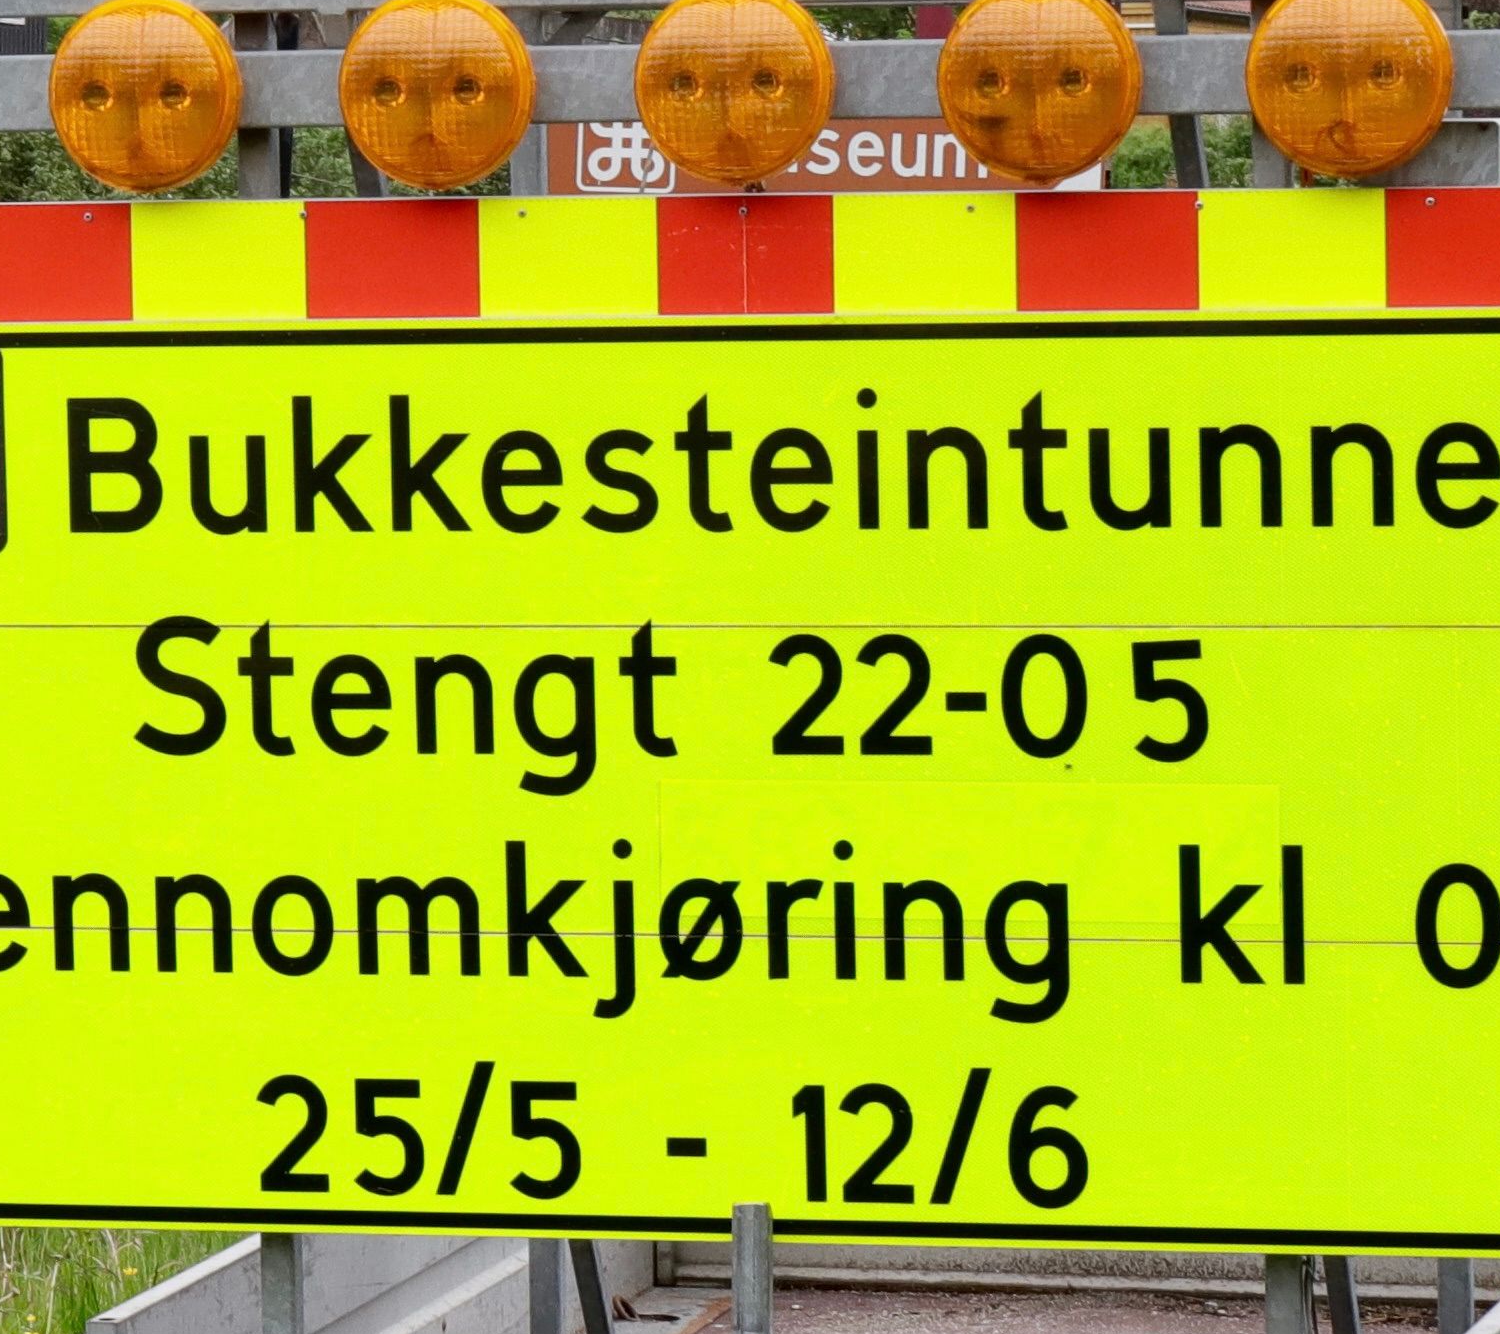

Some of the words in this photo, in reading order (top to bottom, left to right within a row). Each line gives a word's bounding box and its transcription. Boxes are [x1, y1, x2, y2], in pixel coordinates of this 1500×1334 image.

[785, 128, 988, 179] seum
[134, 615, 678, 797] Stengt
[769, 633, 1209, 763] 22-05
[1179, 844, 1305, 986] kl
[257, 1061, 581, 1200] 25/5
[666, 1137, 707, 1157] -
[792, 1067, 1089, 1209] 12/6
